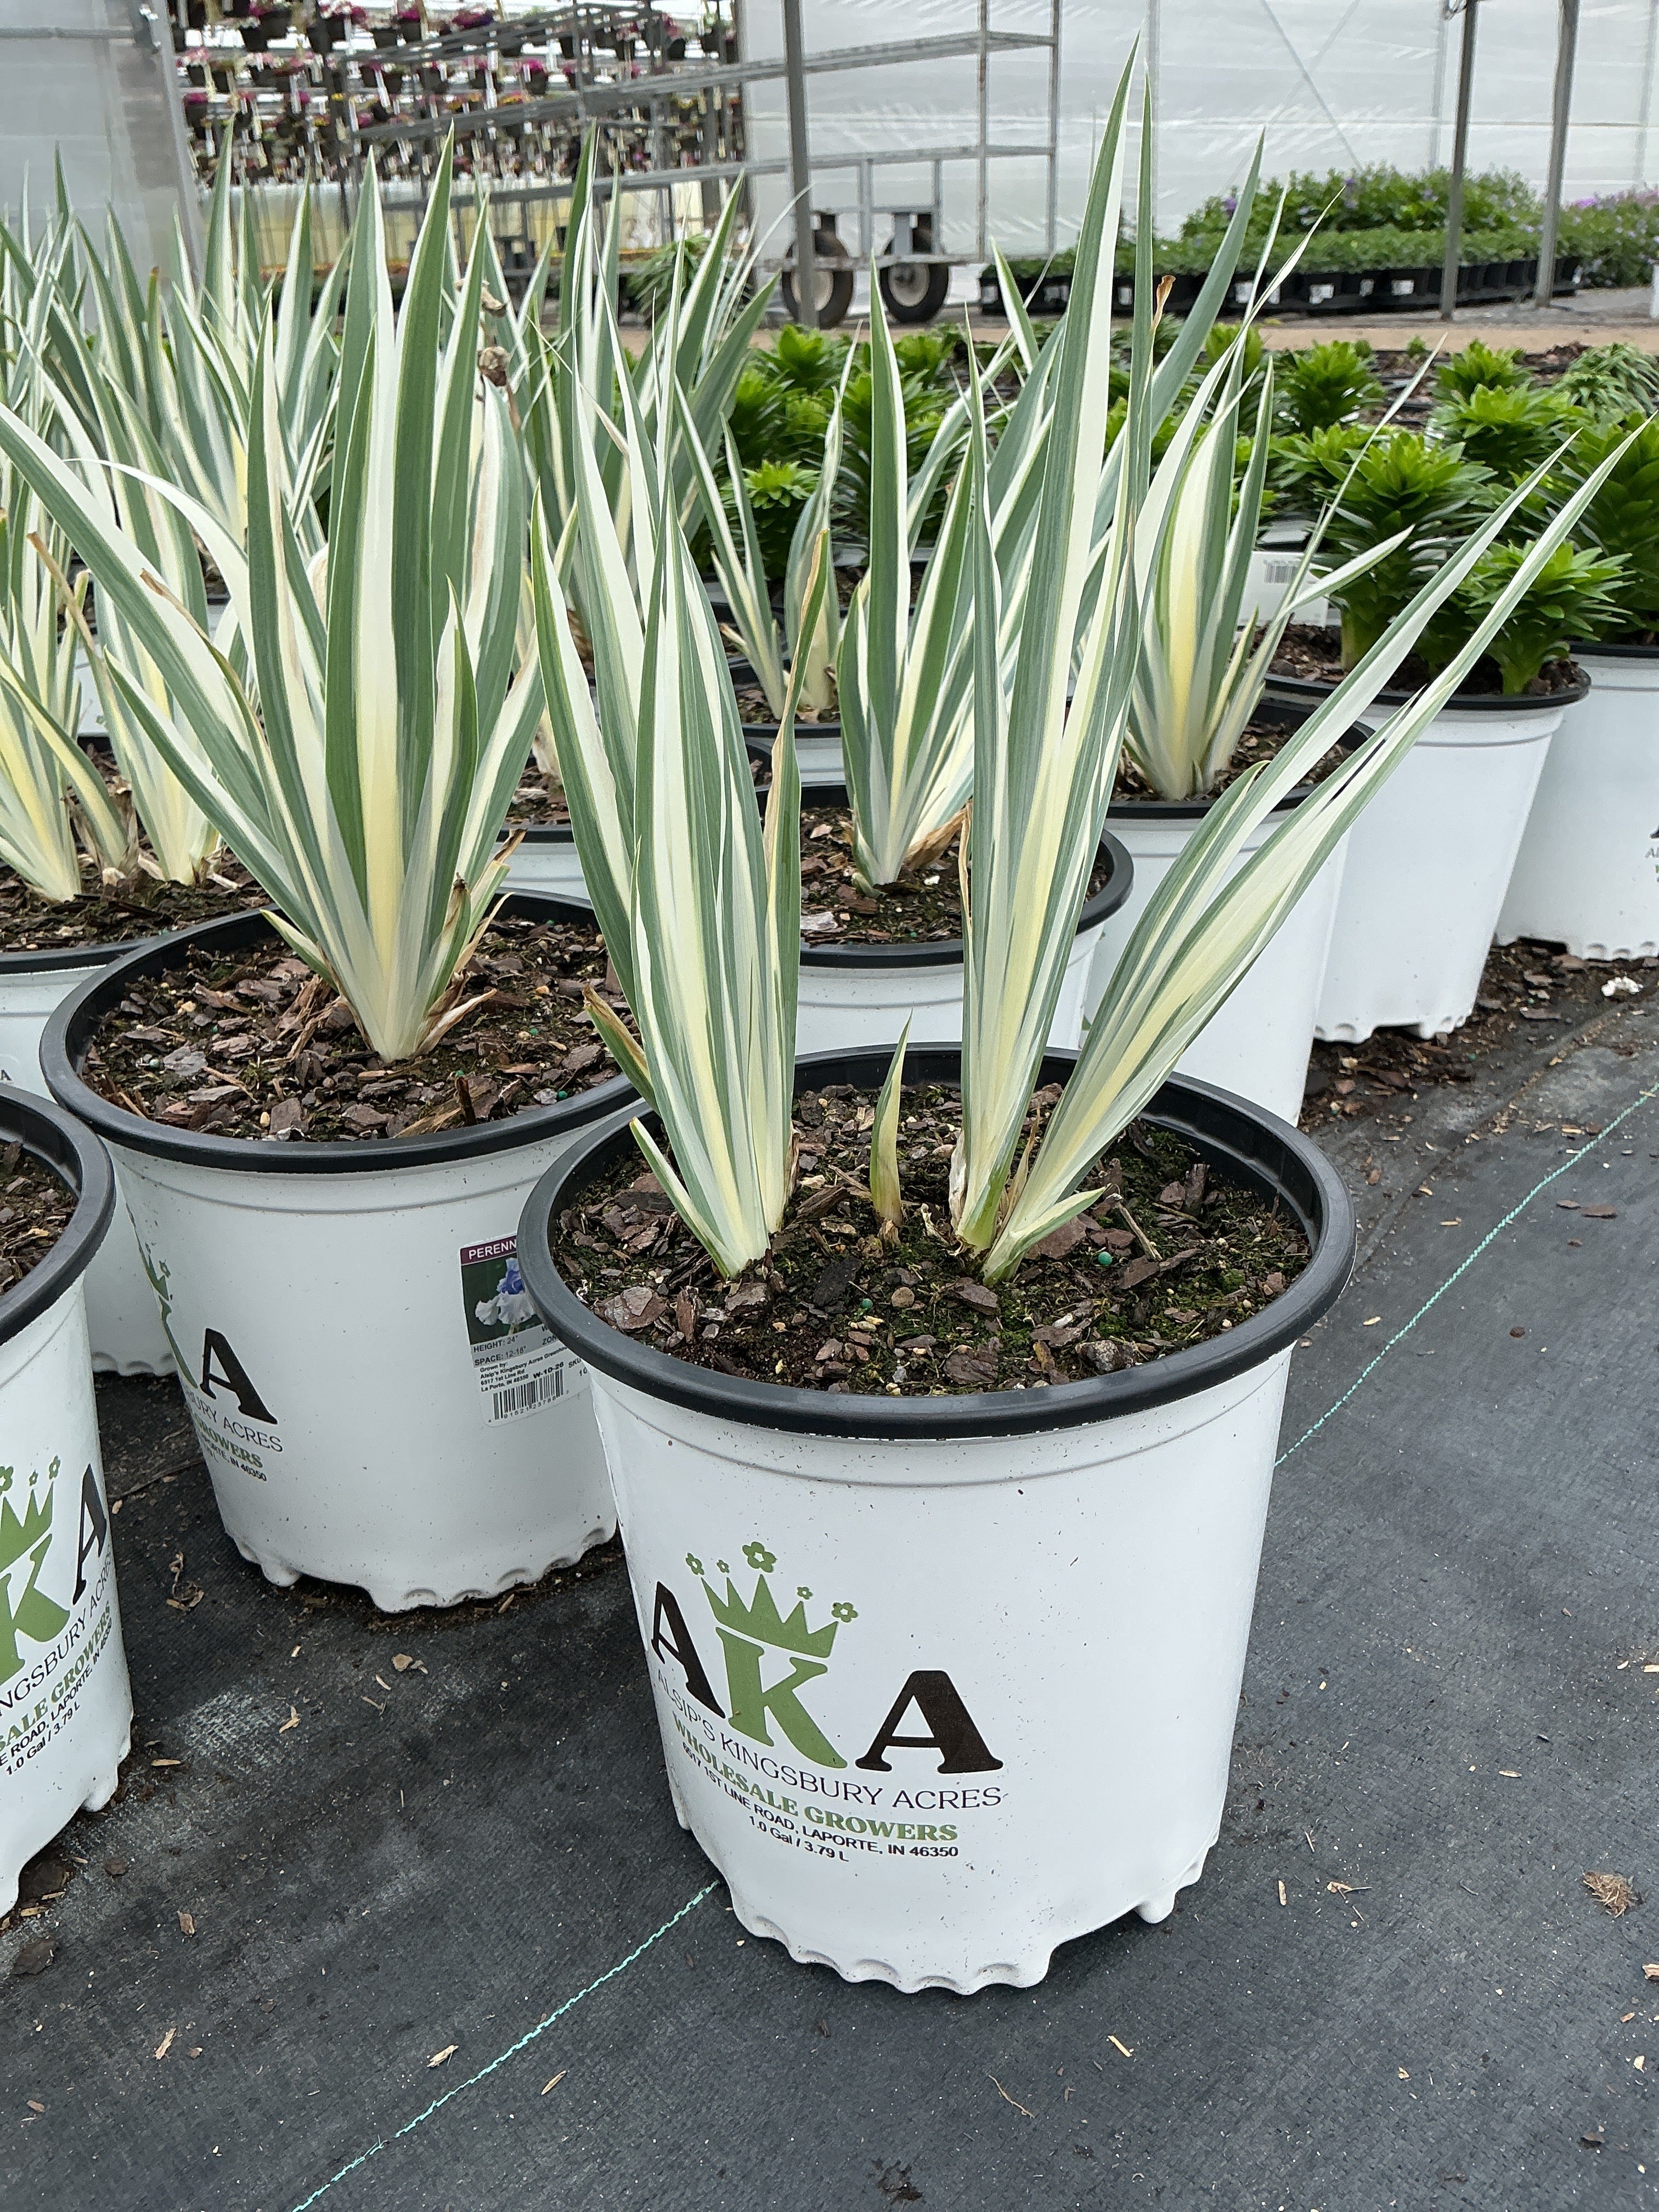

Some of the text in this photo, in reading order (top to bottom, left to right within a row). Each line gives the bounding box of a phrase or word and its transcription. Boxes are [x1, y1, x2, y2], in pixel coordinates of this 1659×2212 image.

[469, 1239, 517, 1260] PERENN
[473, 1340, 505, 1353] HEIGHT:
[474, 1345, 526, 1366] SPACE: 12-18"
[500, 1362, 527, 1374] Kingsbury
[528, 1356, 543, 1365] Acres
[223, 1417, 283, 1453] ACRES
[229, 1456, 240, 1469] IN
[240, 1464, 267, 1482] 46350
[51, 1600, 110, 1703] GROWERS
[10, 1721, 49, 1758] ROAD,
[50, 1664, 93, 1721] LAPORTE,
[92, 1647, 100, 1665] IN
[5, 1701, 81, 1776] 1.0 Gal / 3.79 L
[658, 1669, 1002, 1809] ALSIP'S KINGSBURY ACRES
[672, 1710, 958, 1842] WHOLESALE GROWERS
[704, 1766, 722, 1787] 1ST
[724, 1783, 752, 1810] LINE
[754, 1803, 799, 1834] ROAD,
[802, 1825, 884, 1854] LAPORTE,
[888, 1844, 905, 1855] IN
[909, 1846, 959, 1857] 46350
[748, 1815, 849, 1862] 1.0 Gal / 3.79 L
